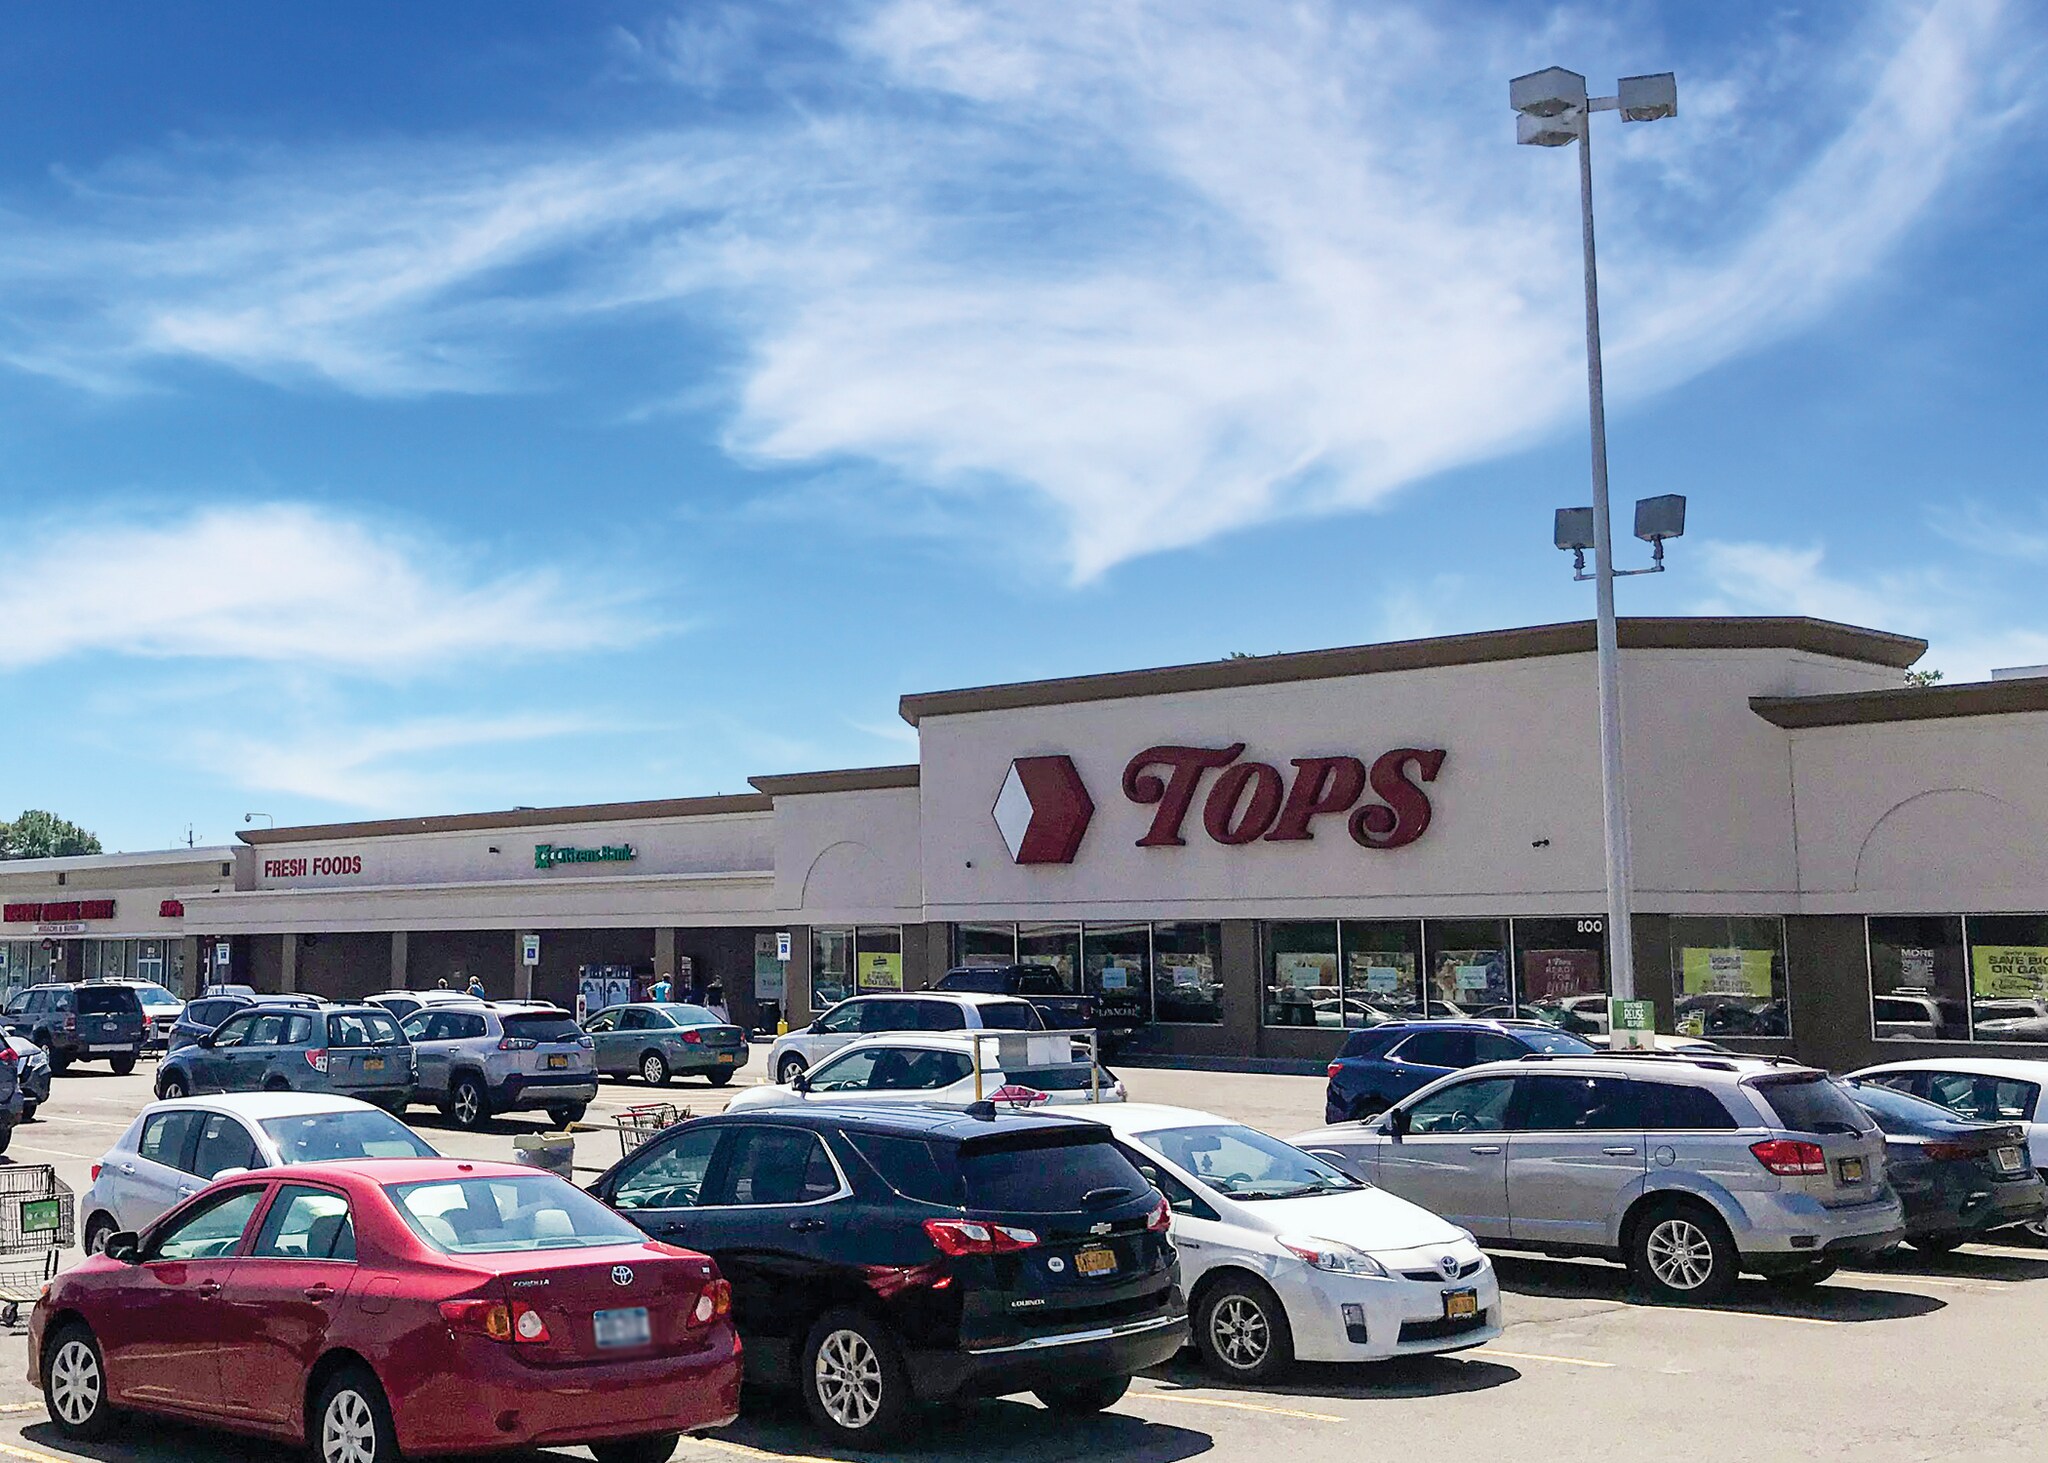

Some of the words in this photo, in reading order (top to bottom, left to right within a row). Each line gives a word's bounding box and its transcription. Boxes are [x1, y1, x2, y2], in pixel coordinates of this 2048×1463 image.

[1121, 742, 1447, 850] TOPS
[264, 858, 308, 878] FRESH
[312, 855, 362, 875] FOODS
[1577, 920, 1603, 933] 800
[1901, 949, 1934, 957] MORE
[1989, 956, 2024, 965] SAVE
[1992, 965, 2013, 974] ON
[2018, 965, 2047, 974] GAS
[1624, 1008, 1645, 1020] REUSE
